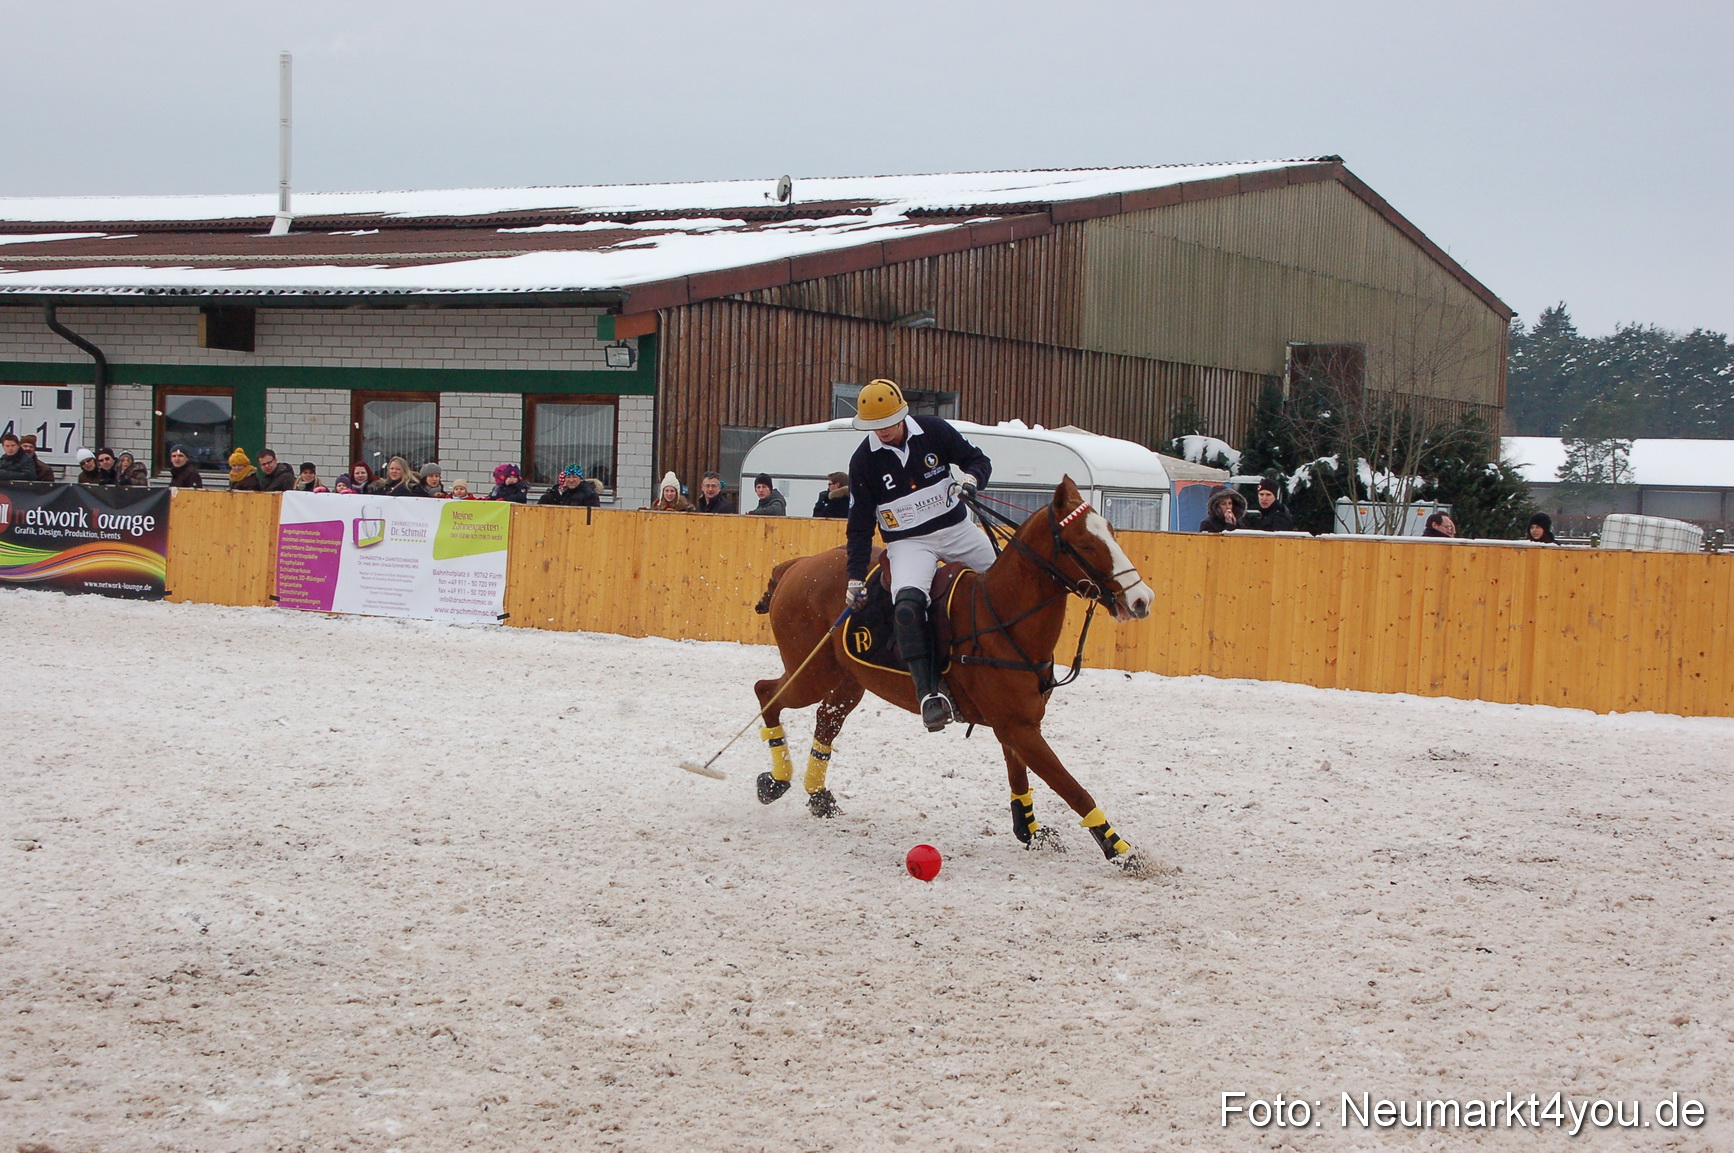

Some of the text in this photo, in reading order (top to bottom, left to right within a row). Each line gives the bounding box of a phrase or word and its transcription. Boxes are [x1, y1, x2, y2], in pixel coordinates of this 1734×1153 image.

[882, 473, 896, 490] 2
[15, 506, 88, 528] network
[92, 508, 155, 536] lounge
[453, 511, 473, 520] Meine
[15, 526, 121, 540] Grafik, Design, Produktion, Events
[391, 527, 427, 537] Dr. Schmitt
[452, 522, 499, 533] Zahnexperten
[433, 568, 466, 577] Bahnhofplatz
[83, 581, 152, 592] www.network-lounge.de
